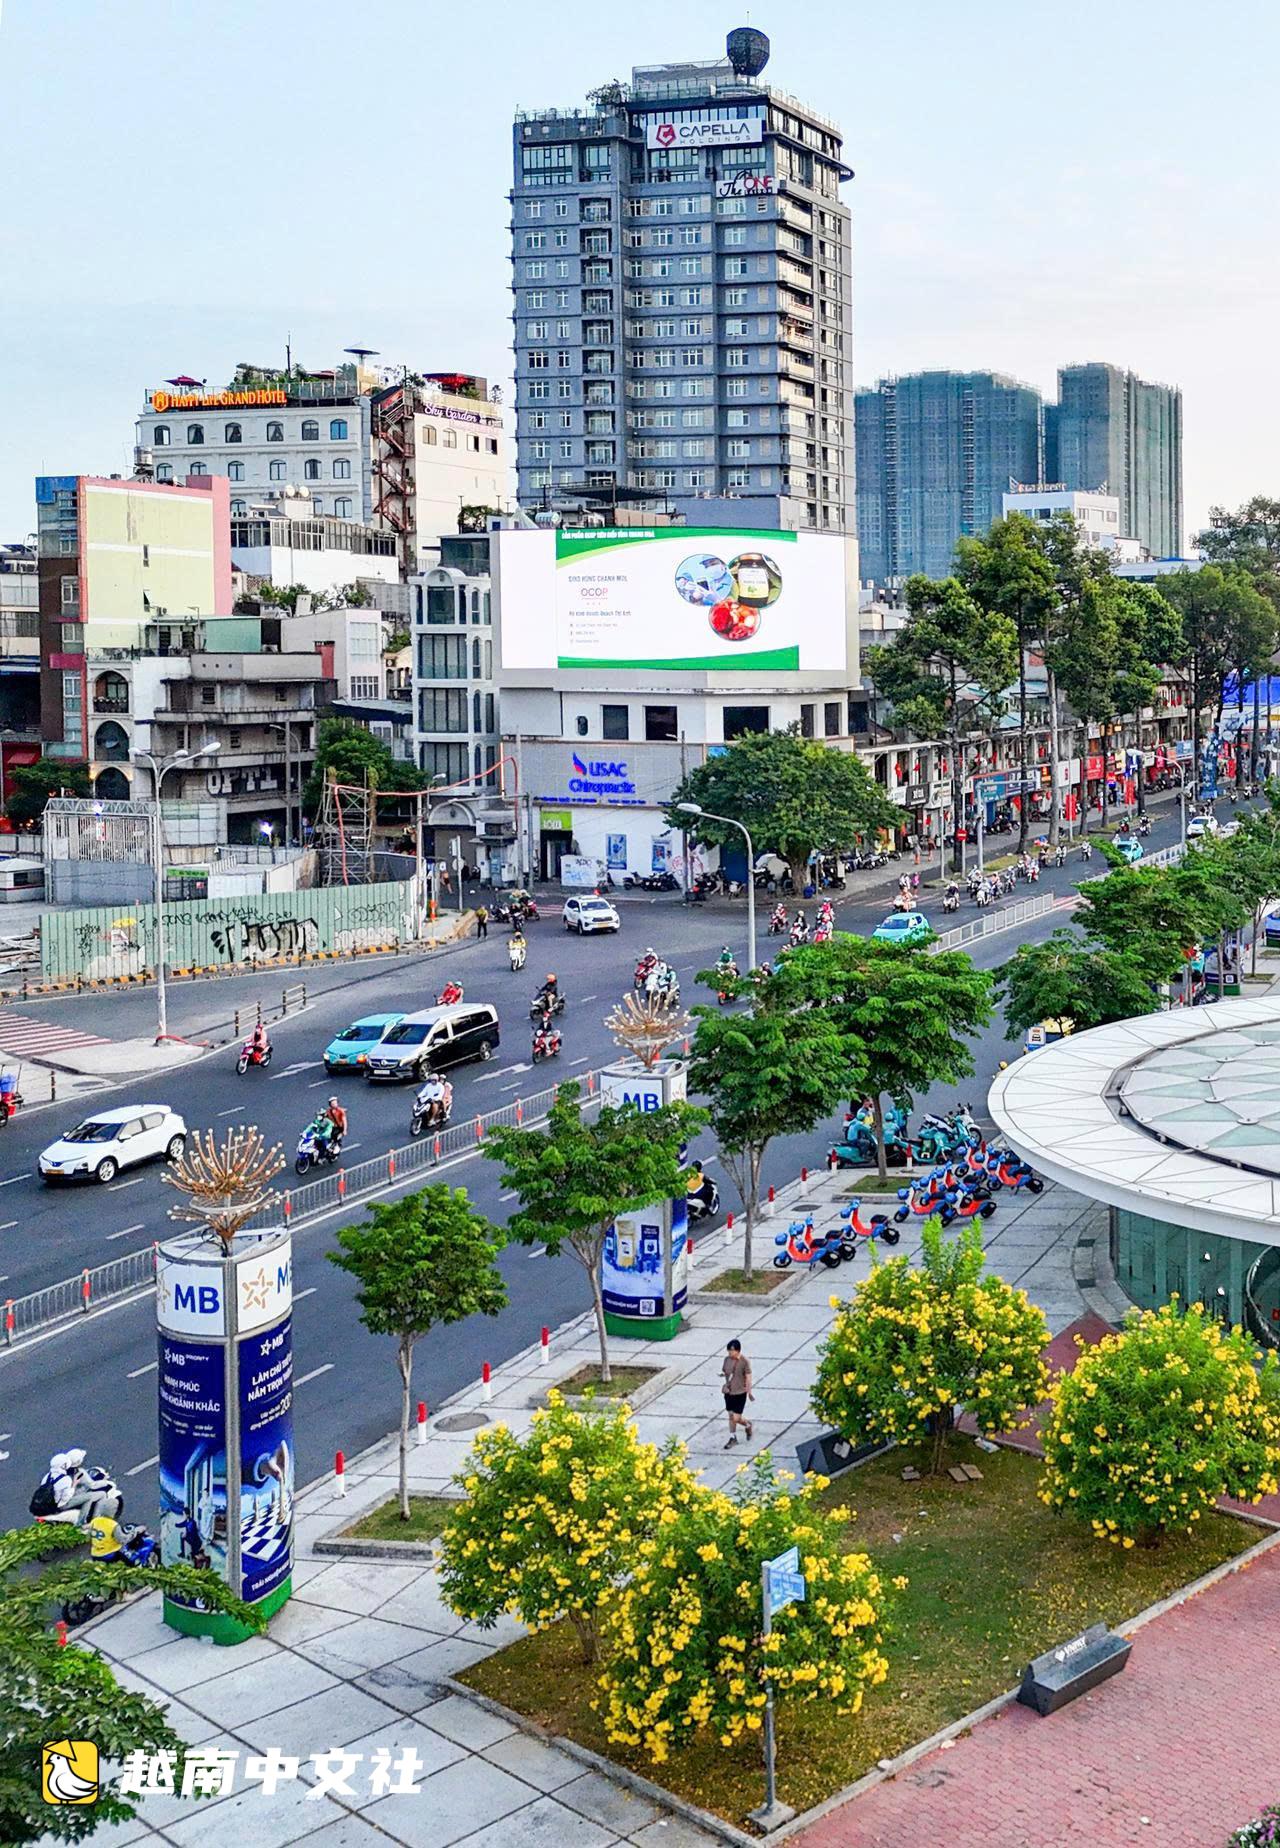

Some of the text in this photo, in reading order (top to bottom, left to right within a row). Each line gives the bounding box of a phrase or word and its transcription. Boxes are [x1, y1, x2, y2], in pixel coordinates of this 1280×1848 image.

[679, 122, 750, 138] CAPELLA
[680, 135, 751, 145] HOLDINGS
[744, 175, 773, 190] ONE
[171, 393, 199, 407] HAPPY
[220, 391, 257, 405] GRAND
[257, 389, 288, 404] HOTEL
[424, 403, 477, 423] Sky Garden
[580, 587, 608, 597] OCOP
[589, 761, 628, 778] USAC
[623, 1092, 660, 1113] MB
[277, 1260, 292, 1294] M
[174, 1283, 221, 1314] MB
[272, 1333, 284, 1350] MB
[172, 1352, 185, 1366] MB
[179, 1380, 200, 1392] PHÚC
[252, 1370, 270, 1386] LÀM
[248, 1385, 267, 1402] NẮM
[195, 1398, 220, 1412] KHẮC
